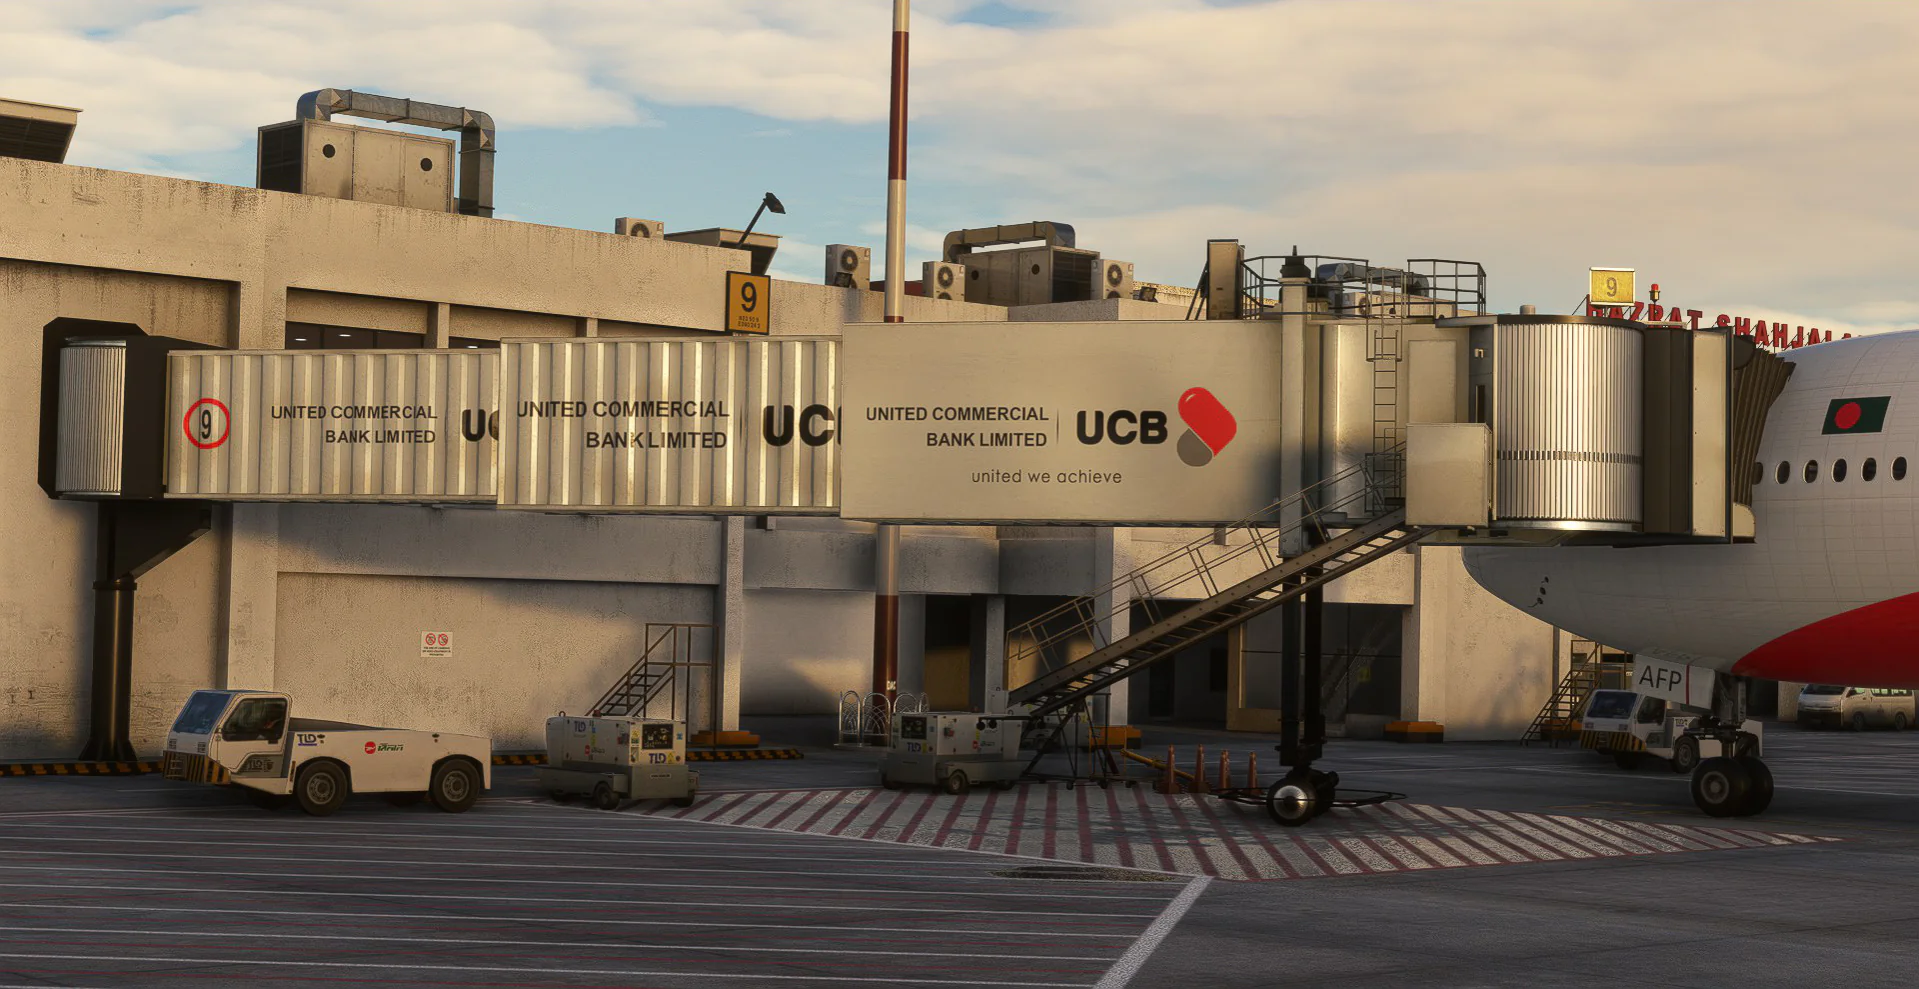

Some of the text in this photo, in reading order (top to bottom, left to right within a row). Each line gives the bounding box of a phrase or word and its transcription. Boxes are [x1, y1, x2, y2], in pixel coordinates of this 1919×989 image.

[1606, 277, 1617, 297] 9
[741, 281, 757, 313] 9
[271, 405, 438, 419] UNITED COMMERCIAL
[517, 400, 730, 418] UNITED COMMERCIAL
[866, 406, 1050, 421] UNITED COMMERCIAL
[201, 410, 212, 439] 9
[763, 403, 842, 447] UC
[1076, 410, 1168, 446] UCB
[325, 430, 436, 444] BANK LIMITED
[586, 431, 728, 449] BANK LIMITED
[926, 432, 1048, 447] BANK LIMITED
[971, 469, 1122, 484] united we achieve
[1638, 665, 1682, 692] AFP
[574, 721, 587, 732] TLD
[297, 733, 317, 744] TLD
[648, 753, 667, 764] TLD
